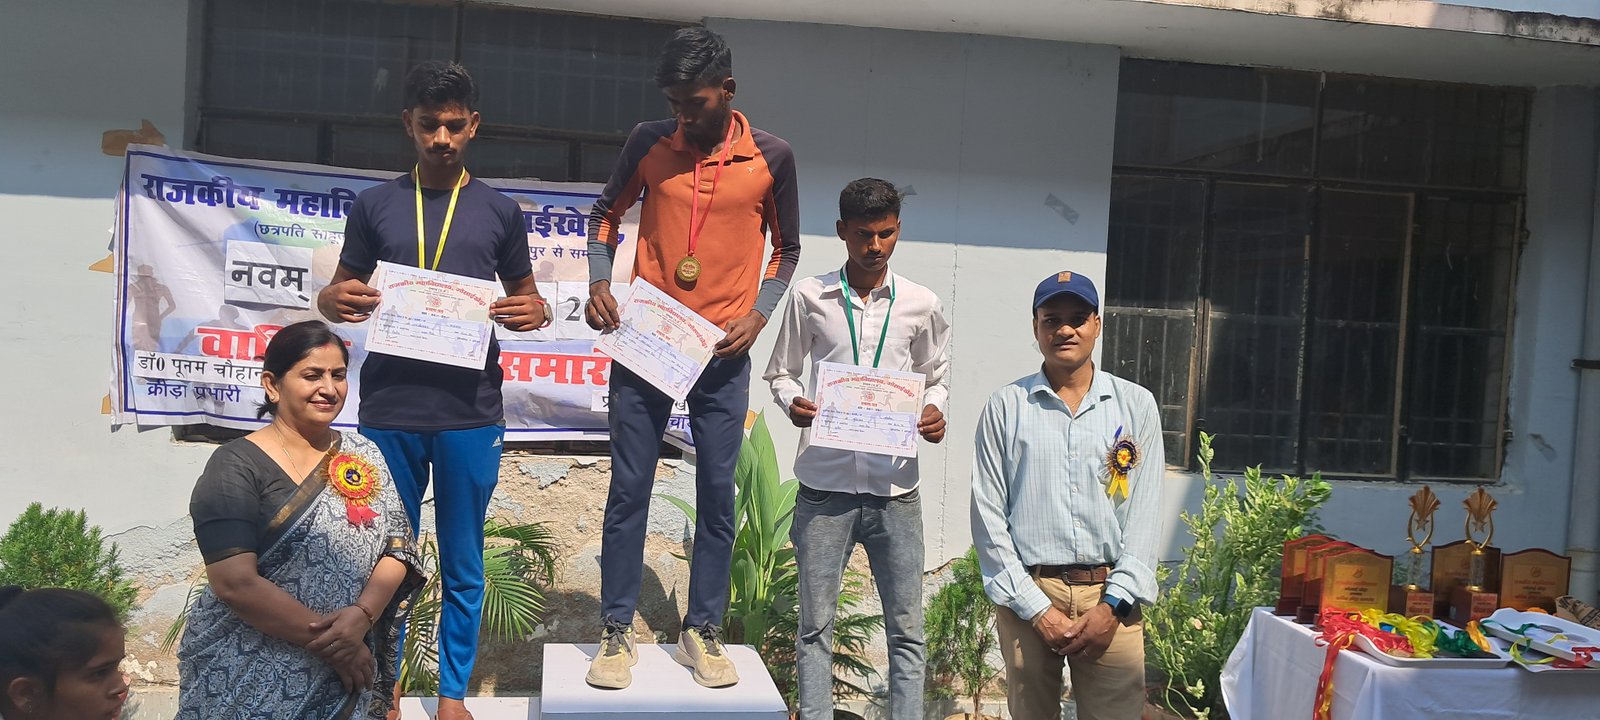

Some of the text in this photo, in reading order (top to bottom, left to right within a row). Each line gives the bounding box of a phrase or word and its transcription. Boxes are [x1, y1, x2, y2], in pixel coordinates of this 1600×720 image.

[141, 174, 265, 210] राजकीय
[254, 220, 305, 239] (छत्रपति
[529, 246, 546, 261] पुर
[552, 244, 564, 257] से
[231, 260, 310, 302] नवम्
[171, 358, 208, 379] पूनम
[213, 359, 263, 384] चौहान
[146, 378, 241, 403] क्रीड़ा प्रभारी
